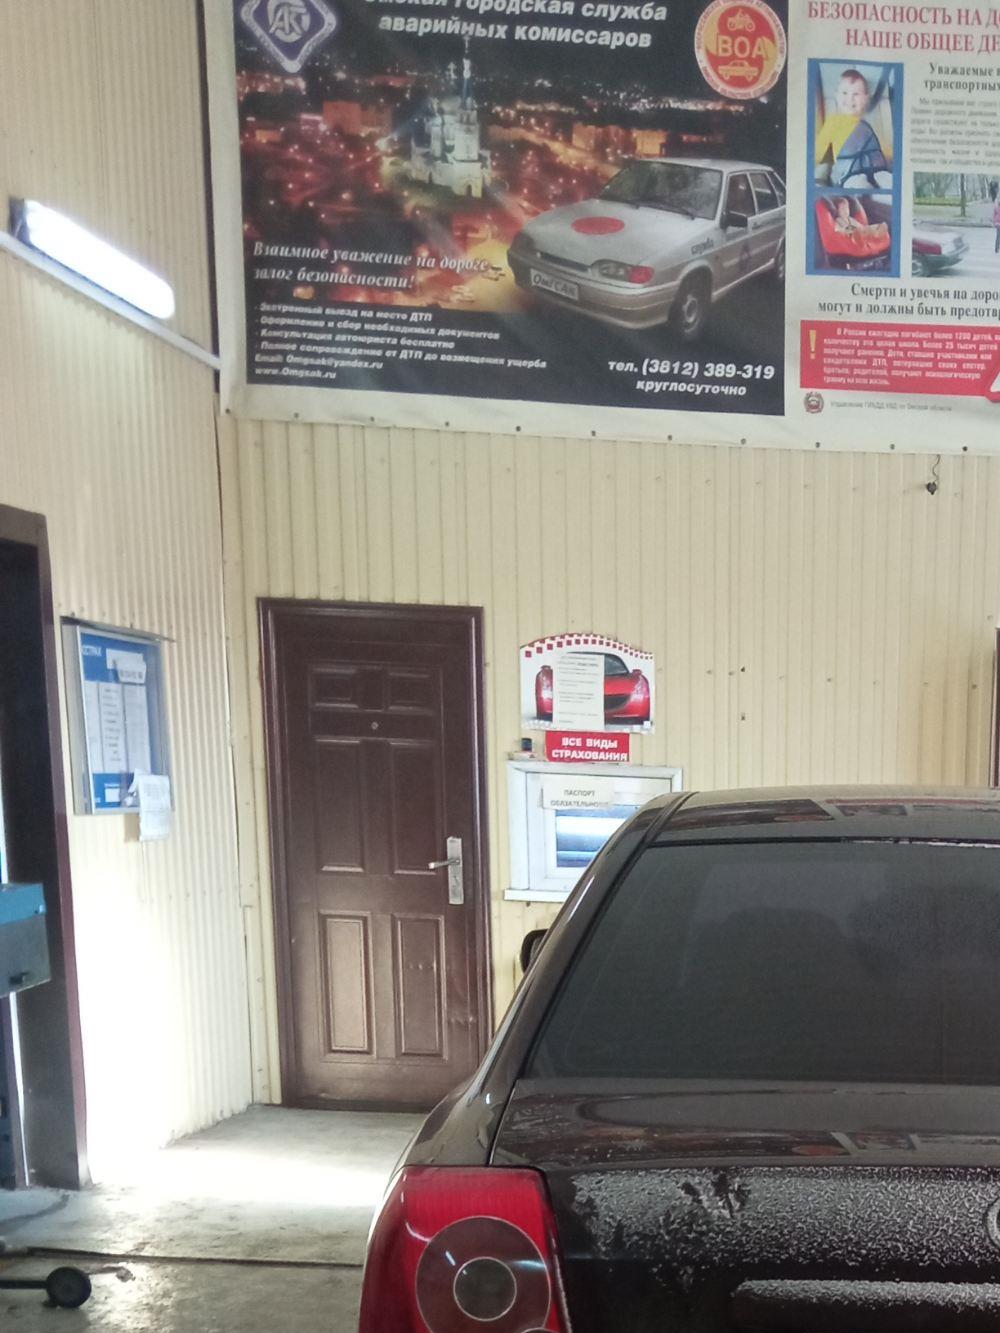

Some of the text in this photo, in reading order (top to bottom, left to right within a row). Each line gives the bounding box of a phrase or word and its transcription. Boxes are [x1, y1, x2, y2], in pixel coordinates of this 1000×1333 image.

[581, 1, 667, 21] служба
[808, 1, 952, 25] БЕЗОПАСНОСТЬ
[957, 9, 982, 26] НА
[379, 15, 652, 49] аварийных комиссаров
[846, 29, 902, 49] НАШЕ
[907, 31, 974, 53] ОБЩЕЕ
[929, 62, 993, 77] Уважаемые
[253, 241, 328, 260] Взаимное
[331, 248, 412, 266] уважение
[416, 255, 435, 269] на
[254, 267, 416, 289] залог безопасности!
[851, 283, 896, 300] Смерти
[900, 288, 907, 299] и
[910, 289, 950, 302] увечья
[953, 290, 967, 300] на
[818, 302, 852, 316] могут
[855, 304, 863, 314] и
[866, 304, 914, 318] должны
[917, 303, 946, 317] быть
[608, 359, 775, 379] тел. (3812) 389-319
[636, 379, 747, 396] круглосуточно
[562, 737, 618, 750] ВСЕ ВИДЫ
[552, 749, 628, 761] СТРАХОВАНИЯ
[564, 789, 596, 798] ПАСПОРТ
